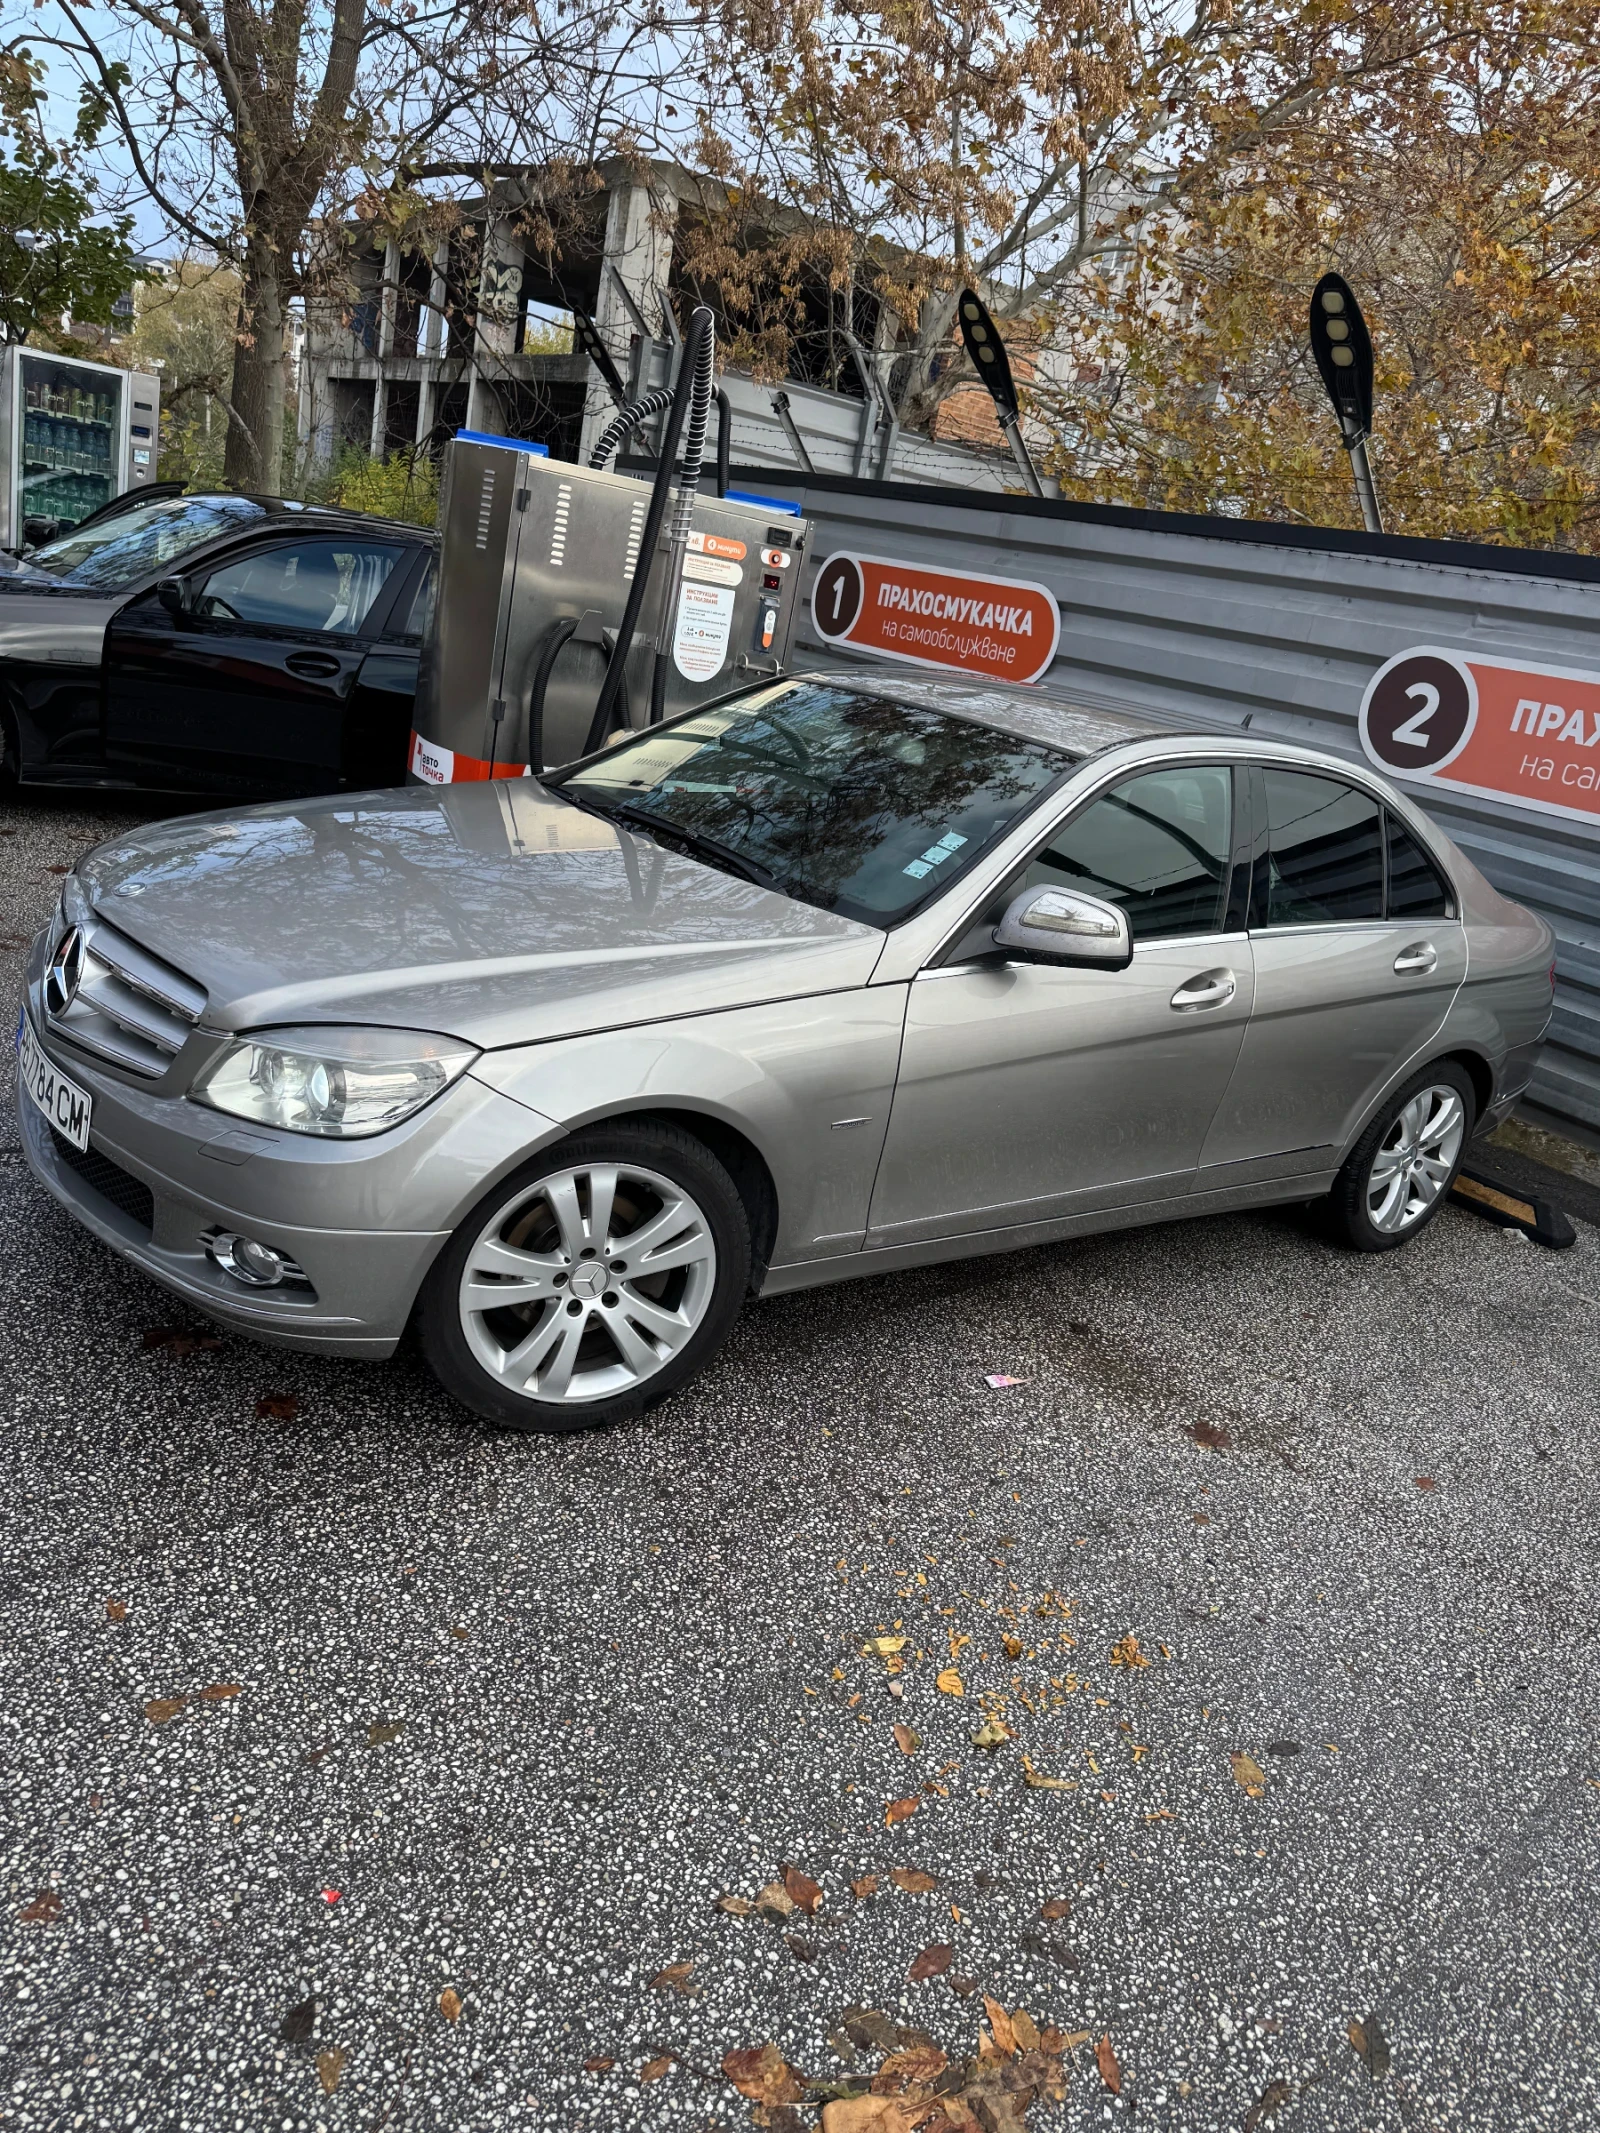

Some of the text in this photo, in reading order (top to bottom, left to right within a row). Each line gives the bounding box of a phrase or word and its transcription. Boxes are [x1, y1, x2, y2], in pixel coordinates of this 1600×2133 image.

[833, 576, 845, 619] 1
[877, 583, 1032, 636] ПРАХОСМУКАЧКА
[881, 619, 1016, 664] на самообслужване
[1392, 682, 1440, 748] 2
[422, 753, 438, 768] авто
[422, 764, 444, 783] точка
[1519, 754, 1555, 780] на
